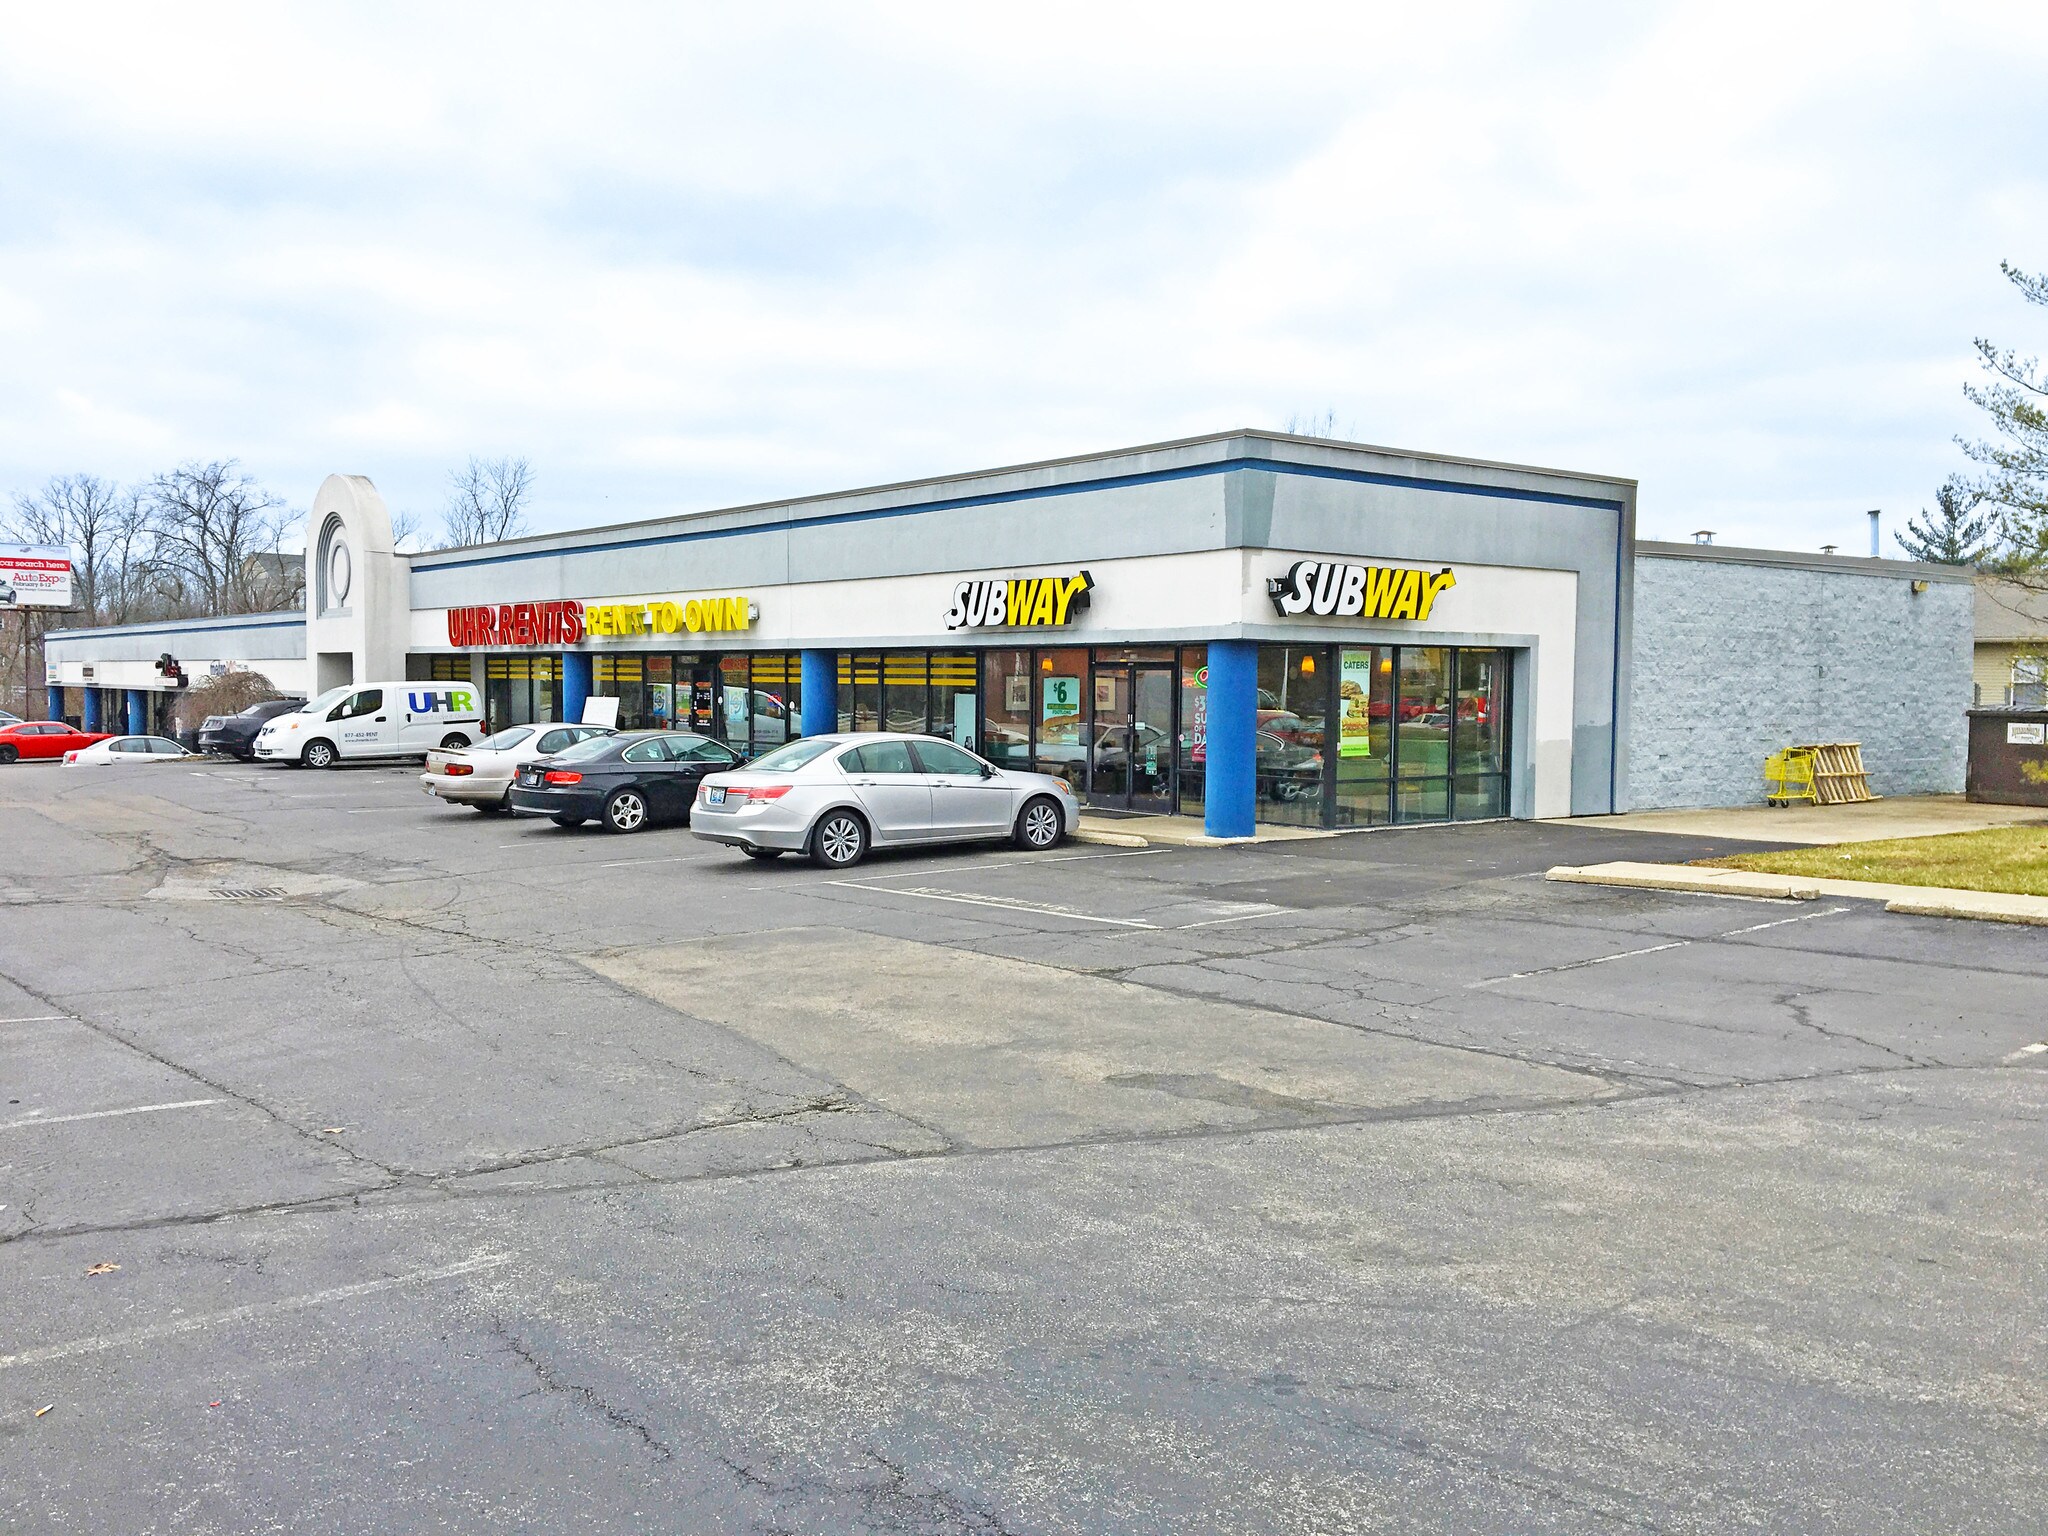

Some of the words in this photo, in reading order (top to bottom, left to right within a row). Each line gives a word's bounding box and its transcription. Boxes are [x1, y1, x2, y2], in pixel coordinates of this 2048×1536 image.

[15, 560, 45, 568] search
[46, 561, 67, 569] here.
[943, 571, 1091, 630] SUBWAY
[1278, 560, 1457, 621] SUBWAY
[447, 606, 496, 647] UHR
[498, 600, 583, 645] RENTS
[647, 601, 683, 634] TO
[685, 597, 749, 633] OWN
[1343, 660, 1369, 670] CATERS
[408, 691, 474, 713] UHR
[1053, 681, 1067, 703] $6
[1194, 712, 1207, 724] SU
[1194, 733, 1207, 745] DA
